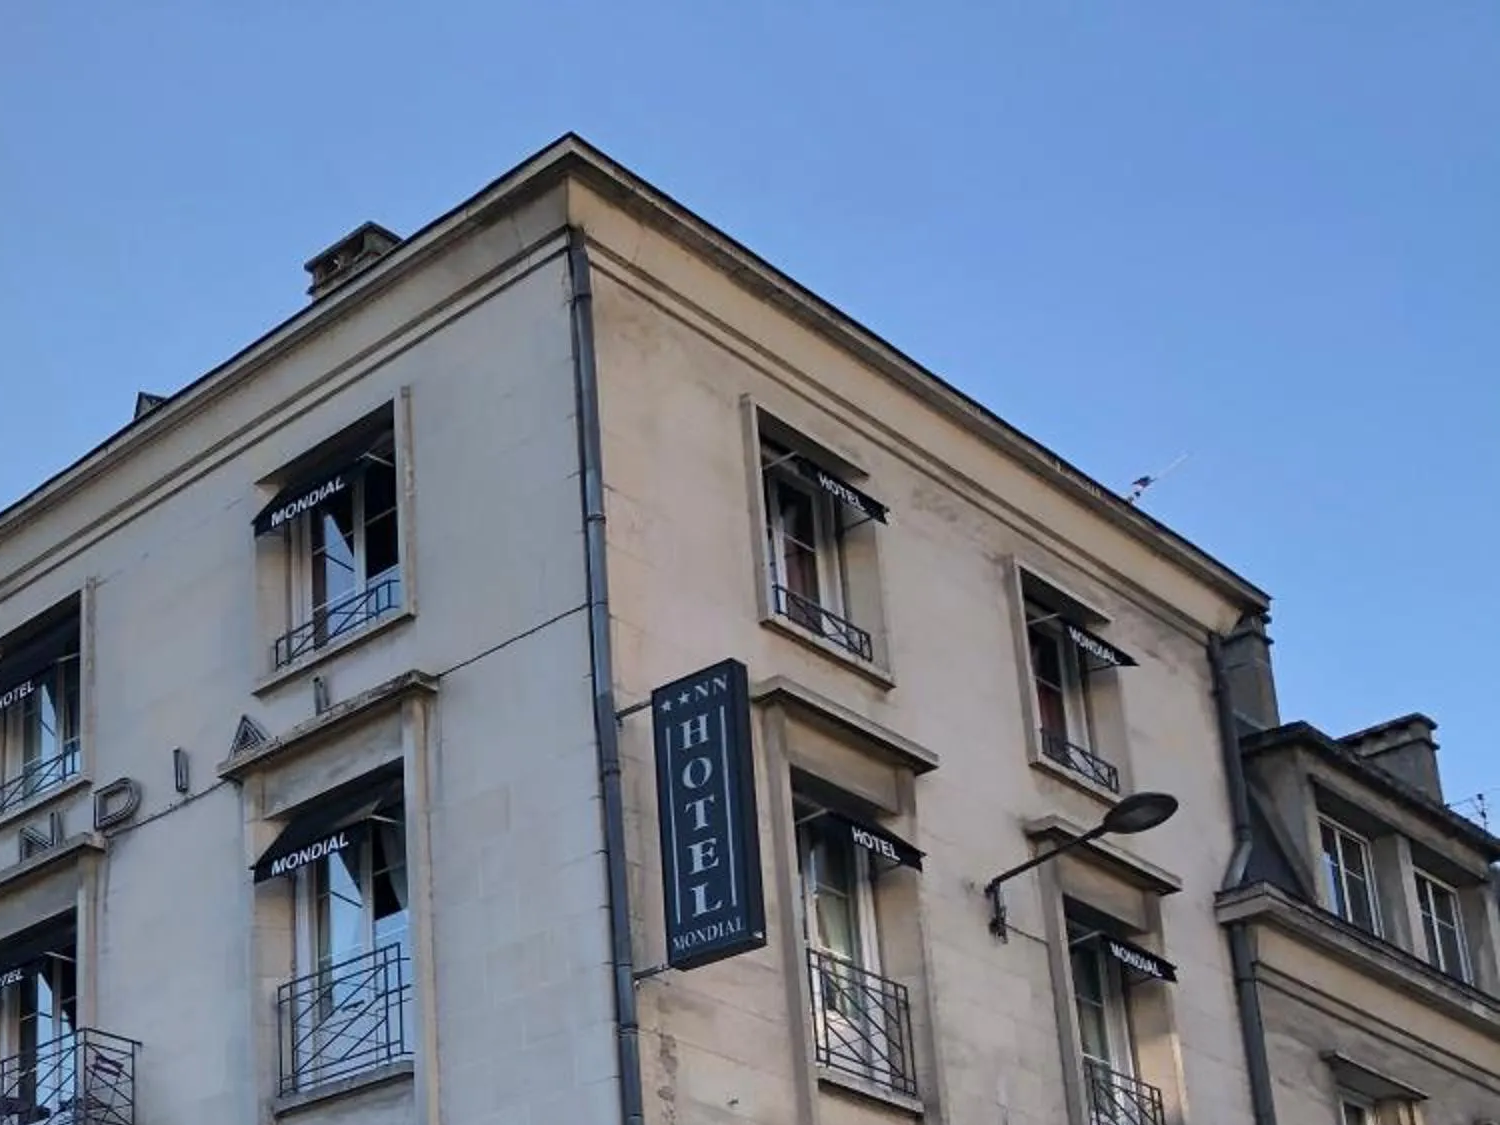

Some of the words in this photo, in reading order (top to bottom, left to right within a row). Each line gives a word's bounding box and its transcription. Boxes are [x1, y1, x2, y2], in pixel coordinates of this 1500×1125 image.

[271, 475, 346, 527] MONDIAL
[695, 673, 729, 698] NN
[678, 713, 723, 919] HOTEL
[271, 831, 349, 877] MONDIAL
[851, 825, 901, 861] HOTEL
[672, 915, 746, 952] MONDIAL
